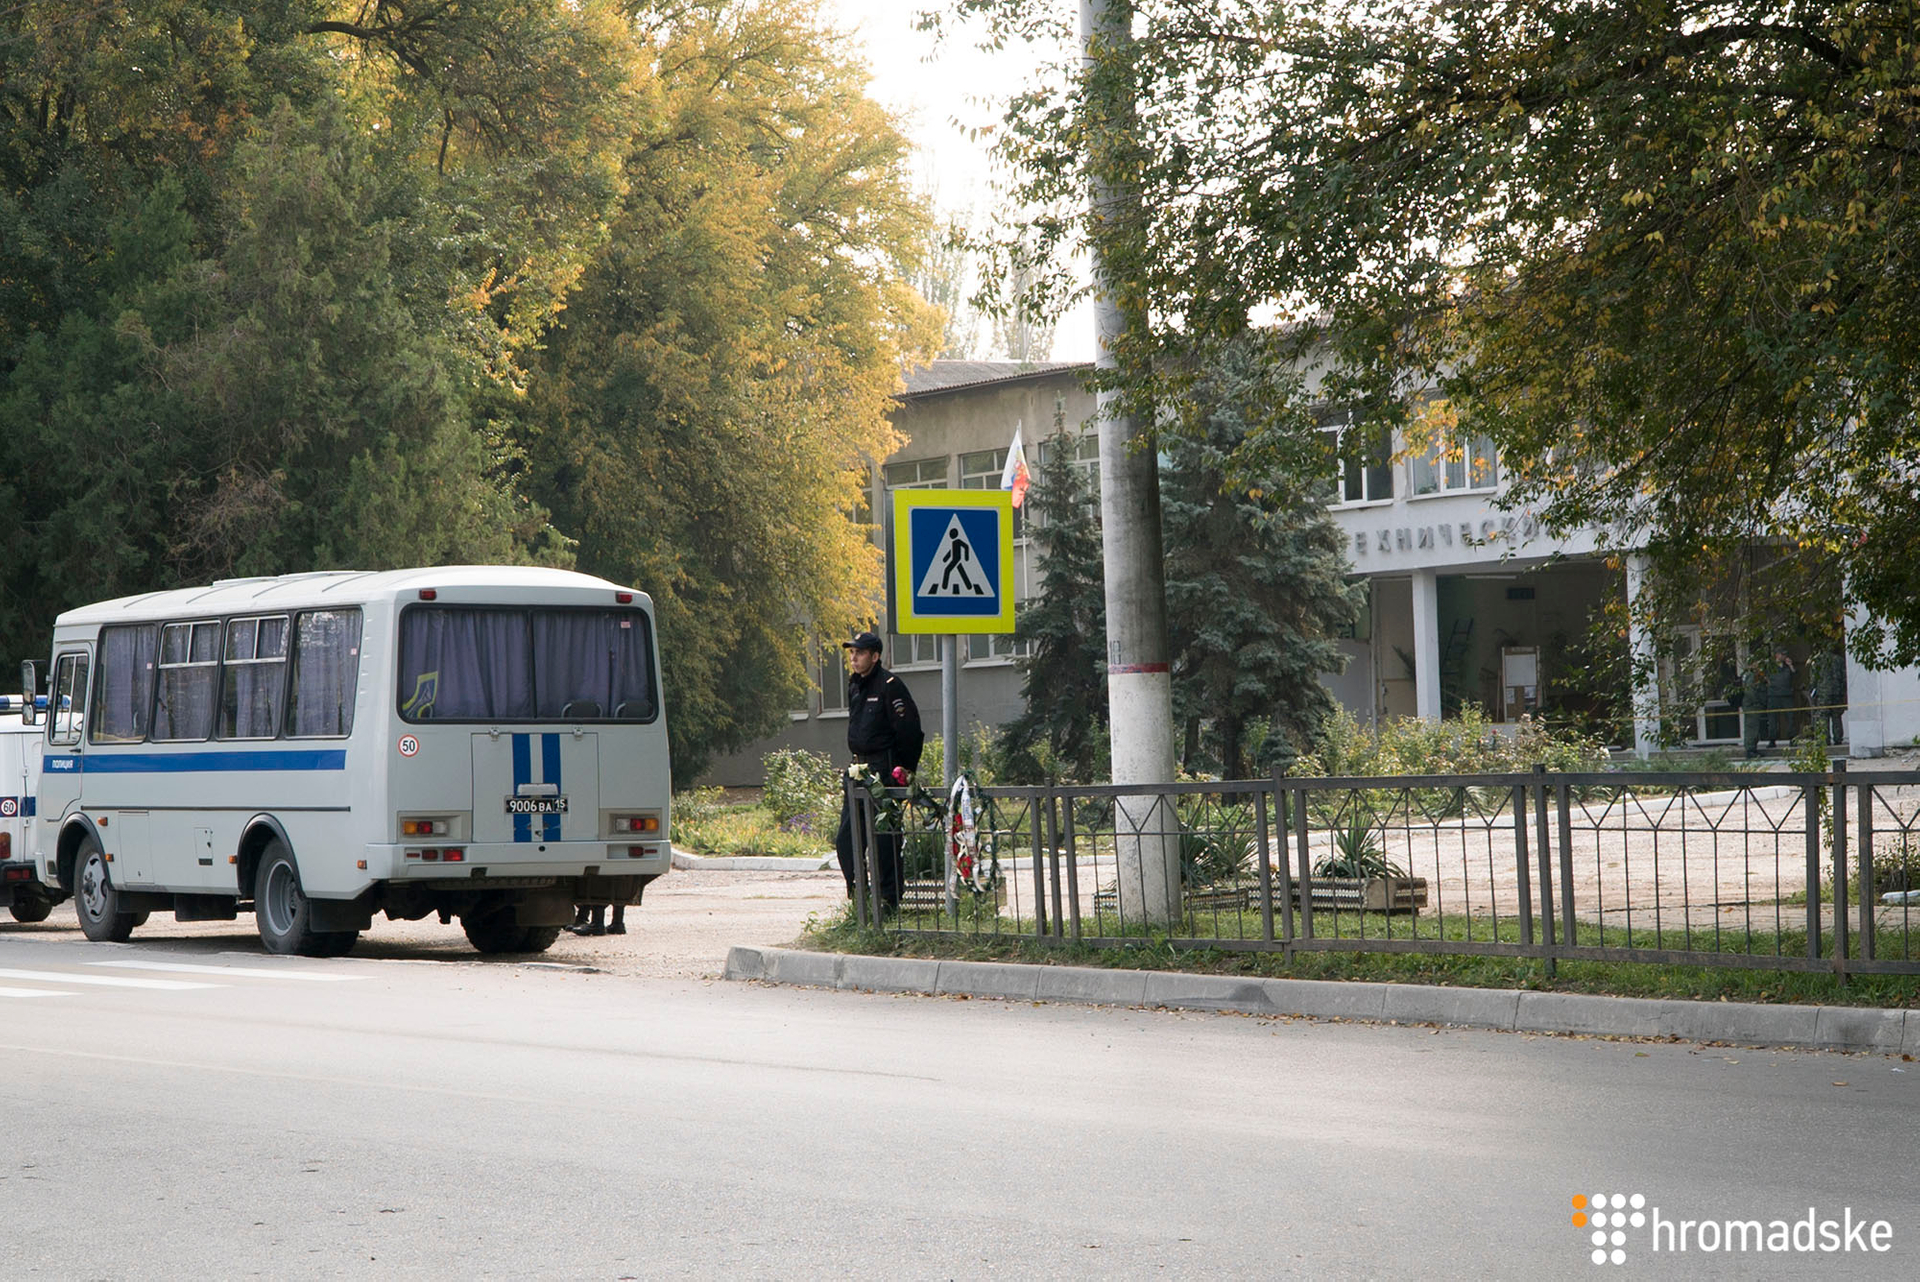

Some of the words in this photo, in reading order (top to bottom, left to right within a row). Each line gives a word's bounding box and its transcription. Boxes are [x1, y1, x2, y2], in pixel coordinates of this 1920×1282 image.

[402, 740, 416, 752] 50
[52, 760, 73, 769] ПОЛИЦИЯ
[3, 802, 14, 812] 60
[555, 799, 566, 808] 15
